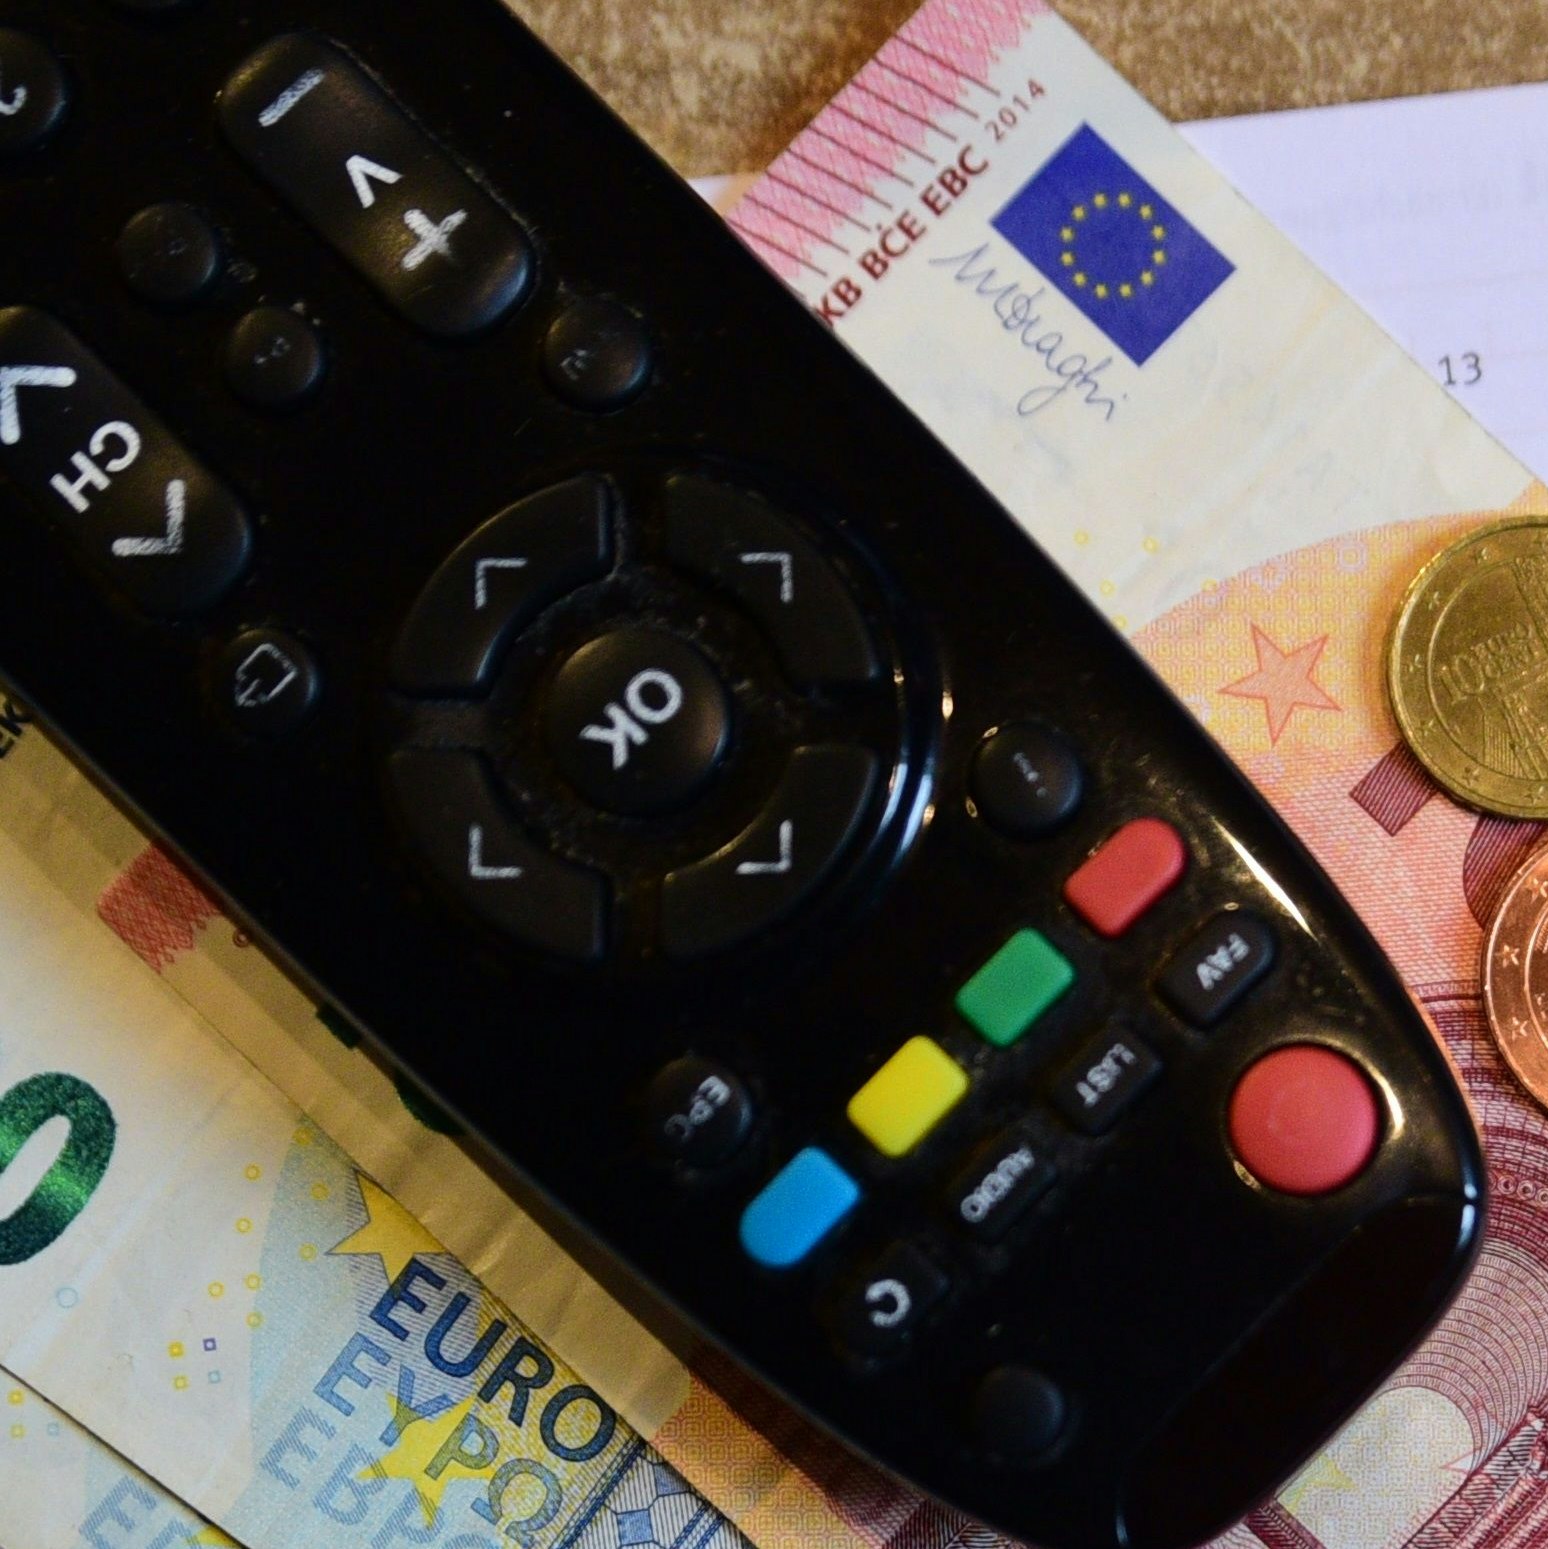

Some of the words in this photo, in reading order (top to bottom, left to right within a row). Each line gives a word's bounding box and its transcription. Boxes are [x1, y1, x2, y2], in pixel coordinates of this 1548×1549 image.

[815, 278, 863, 328] KB
[919, 145, 989, 217] EBC
[984, 78, 1046, 142] 2014
[1437, 352, 1484, 388] 13
[50, 421, 141, 513] CH
[579, 667, 684, 769] OK
[1196, 933, 1250, 990] FAV
[369, 1256, 617, 1462] EURO
